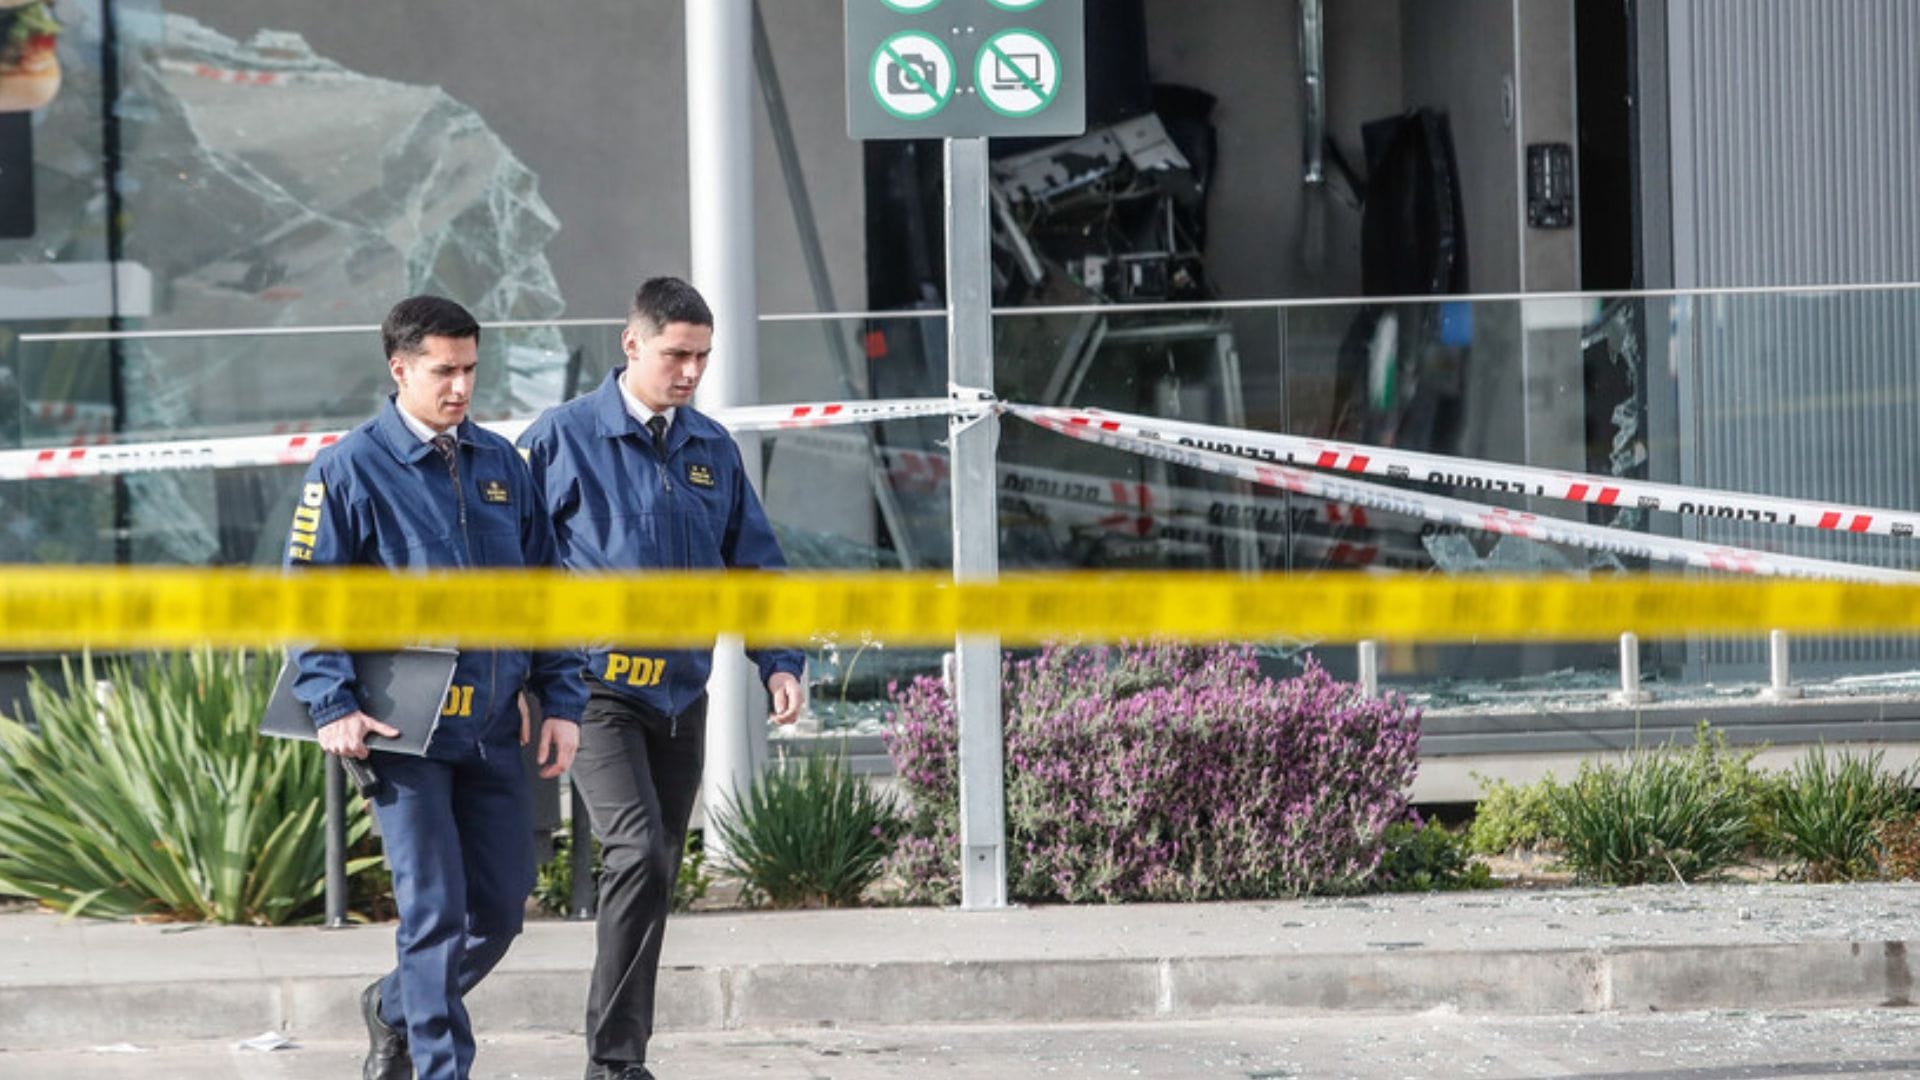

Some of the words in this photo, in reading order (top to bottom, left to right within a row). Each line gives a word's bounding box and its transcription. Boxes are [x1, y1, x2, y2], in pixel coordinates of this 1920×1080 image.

[291, 482, 326, 547] PDI
[604, 653, 666, 687] PDI
[441, 684, 475, 717] DI
